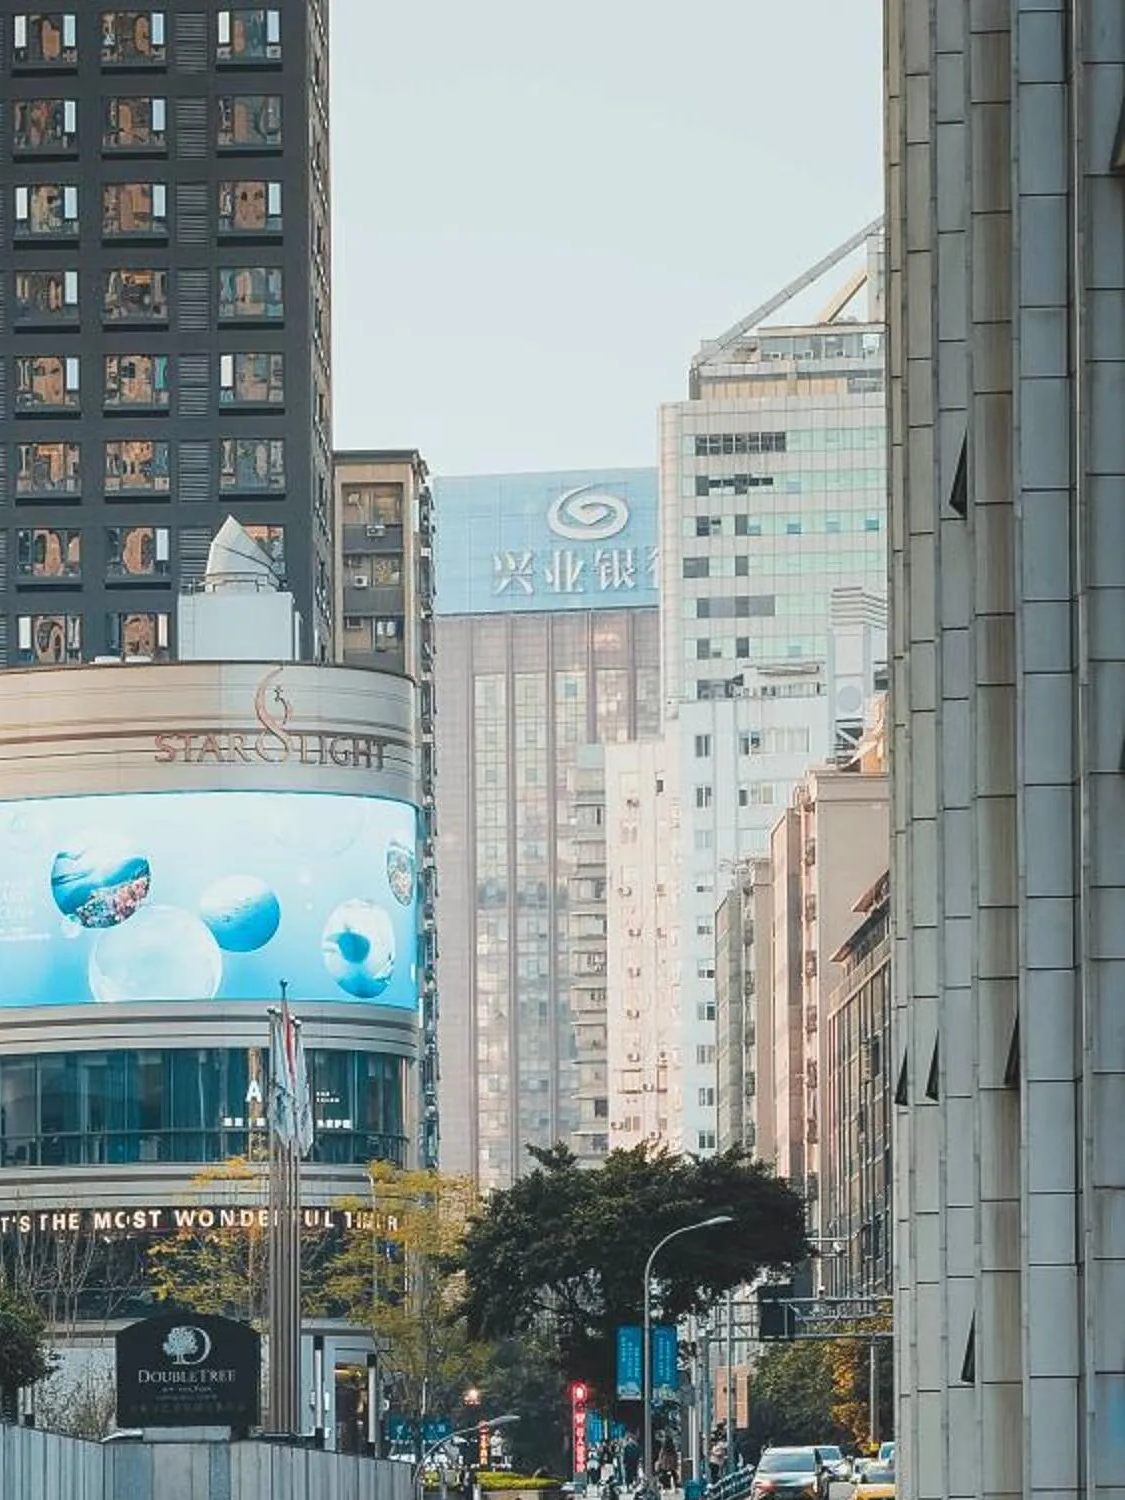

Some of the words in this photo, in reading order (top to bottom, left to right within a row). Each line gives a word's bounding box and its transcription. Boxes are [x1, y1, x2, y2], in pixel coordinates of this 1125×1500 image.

[40, 1213, 80, 1231] THE
[94, 1209, 162, 1229] MOST
[174, 1209, 334, 1228] WONDEUL
